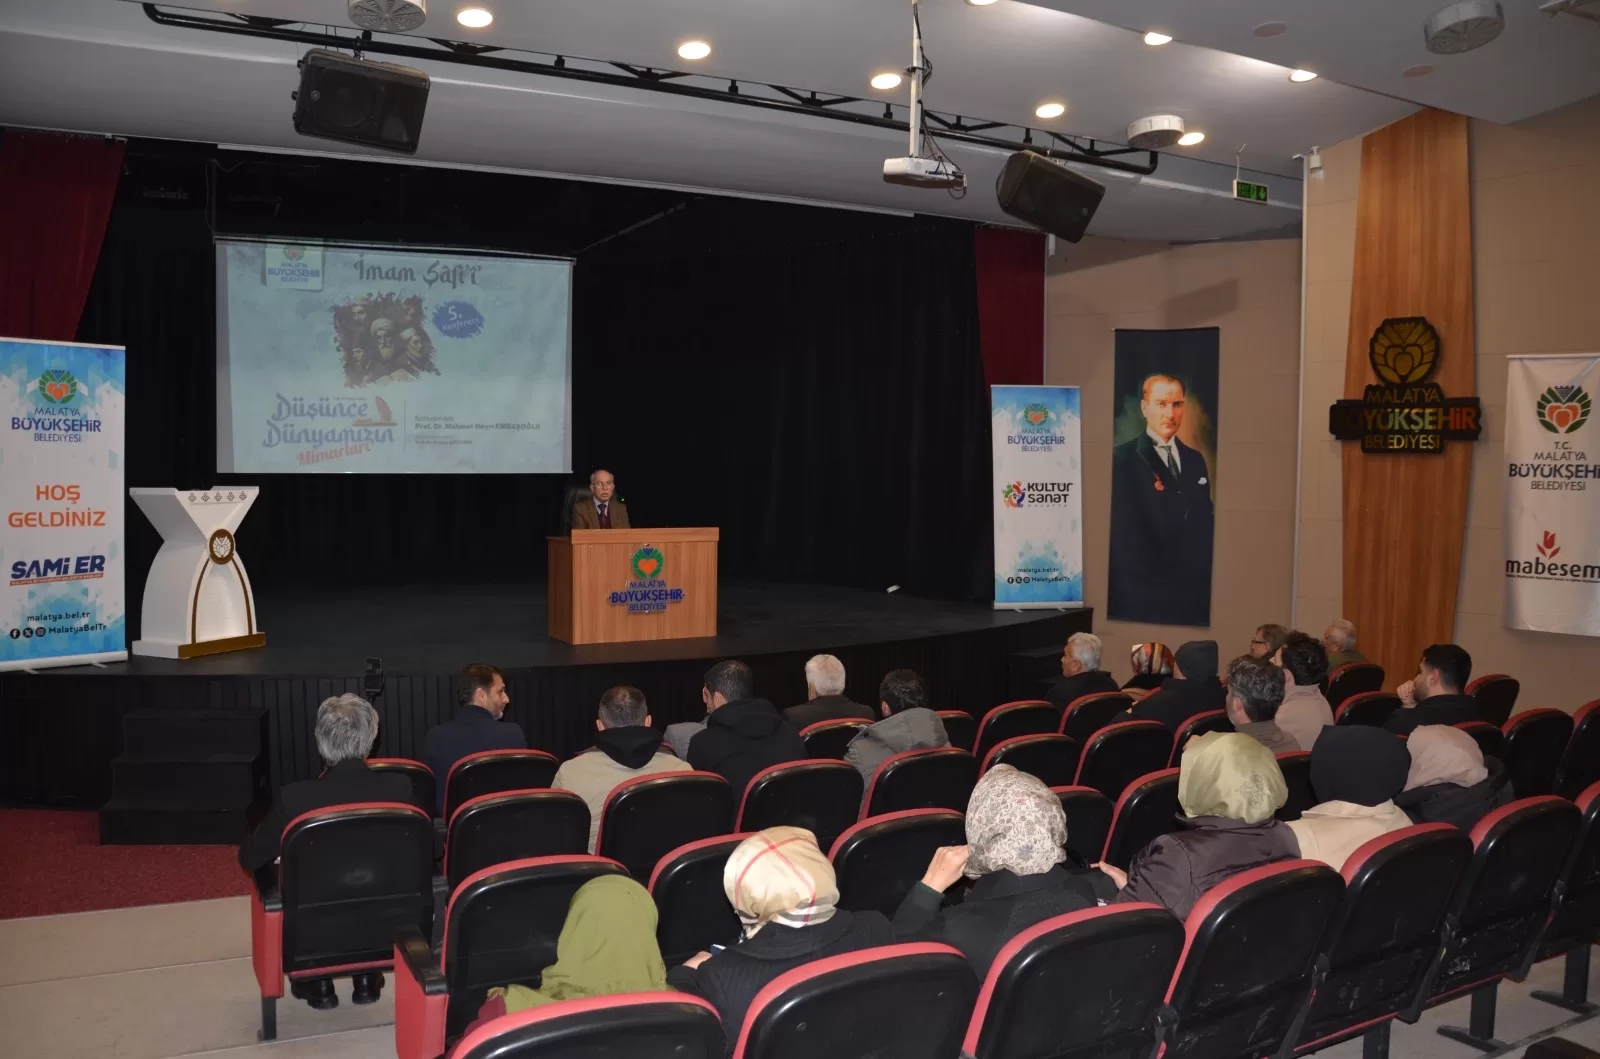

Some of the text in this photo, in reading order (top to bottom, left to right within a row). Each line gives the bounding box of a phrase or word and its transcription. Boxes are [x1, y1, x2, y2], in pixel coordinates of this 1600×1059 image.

[1366, 387, 1441, 404] MALATYA
[34, 407, 81, 416] MALATYA
[271, 392, 369, 421] Düşünce
[11, 417, 102, 433] BÜYÜKŞEHİR
[1338, 407, 1477, 433] YÜKŞEHİR
[34, 433, 81, 443] BELEDİYESİ
[262, 419, 395, 449] Dünyamızın
[1007, 435, 1065, 446] BÜYÜKŞEHİR
[1365, 433, 1441, 449] BELEDİYESİ
[1554, 441, 1572, 450] T.C.
[1533, 451, 1587, 461] MALATYA
[1530, 480, 1587, 491] BELEDİYESİ
[36, 484, 81, 504] HOŞ
[8, 507, 106, 528] GELDİNİZ
[74, 555, 106, 574] ER
[1506, 557, 1600, 579] mabesem
[629, 580, 666, 588] MALATYA
[611, 589, 683, 603] BÜYÜKŞEHİR
[629, 603, 667, 611] BELEDİYESİ
[27, 611, 90, 622] malatya.bel.tr
[48, 623, 107, 635] MalatyaBelTr
